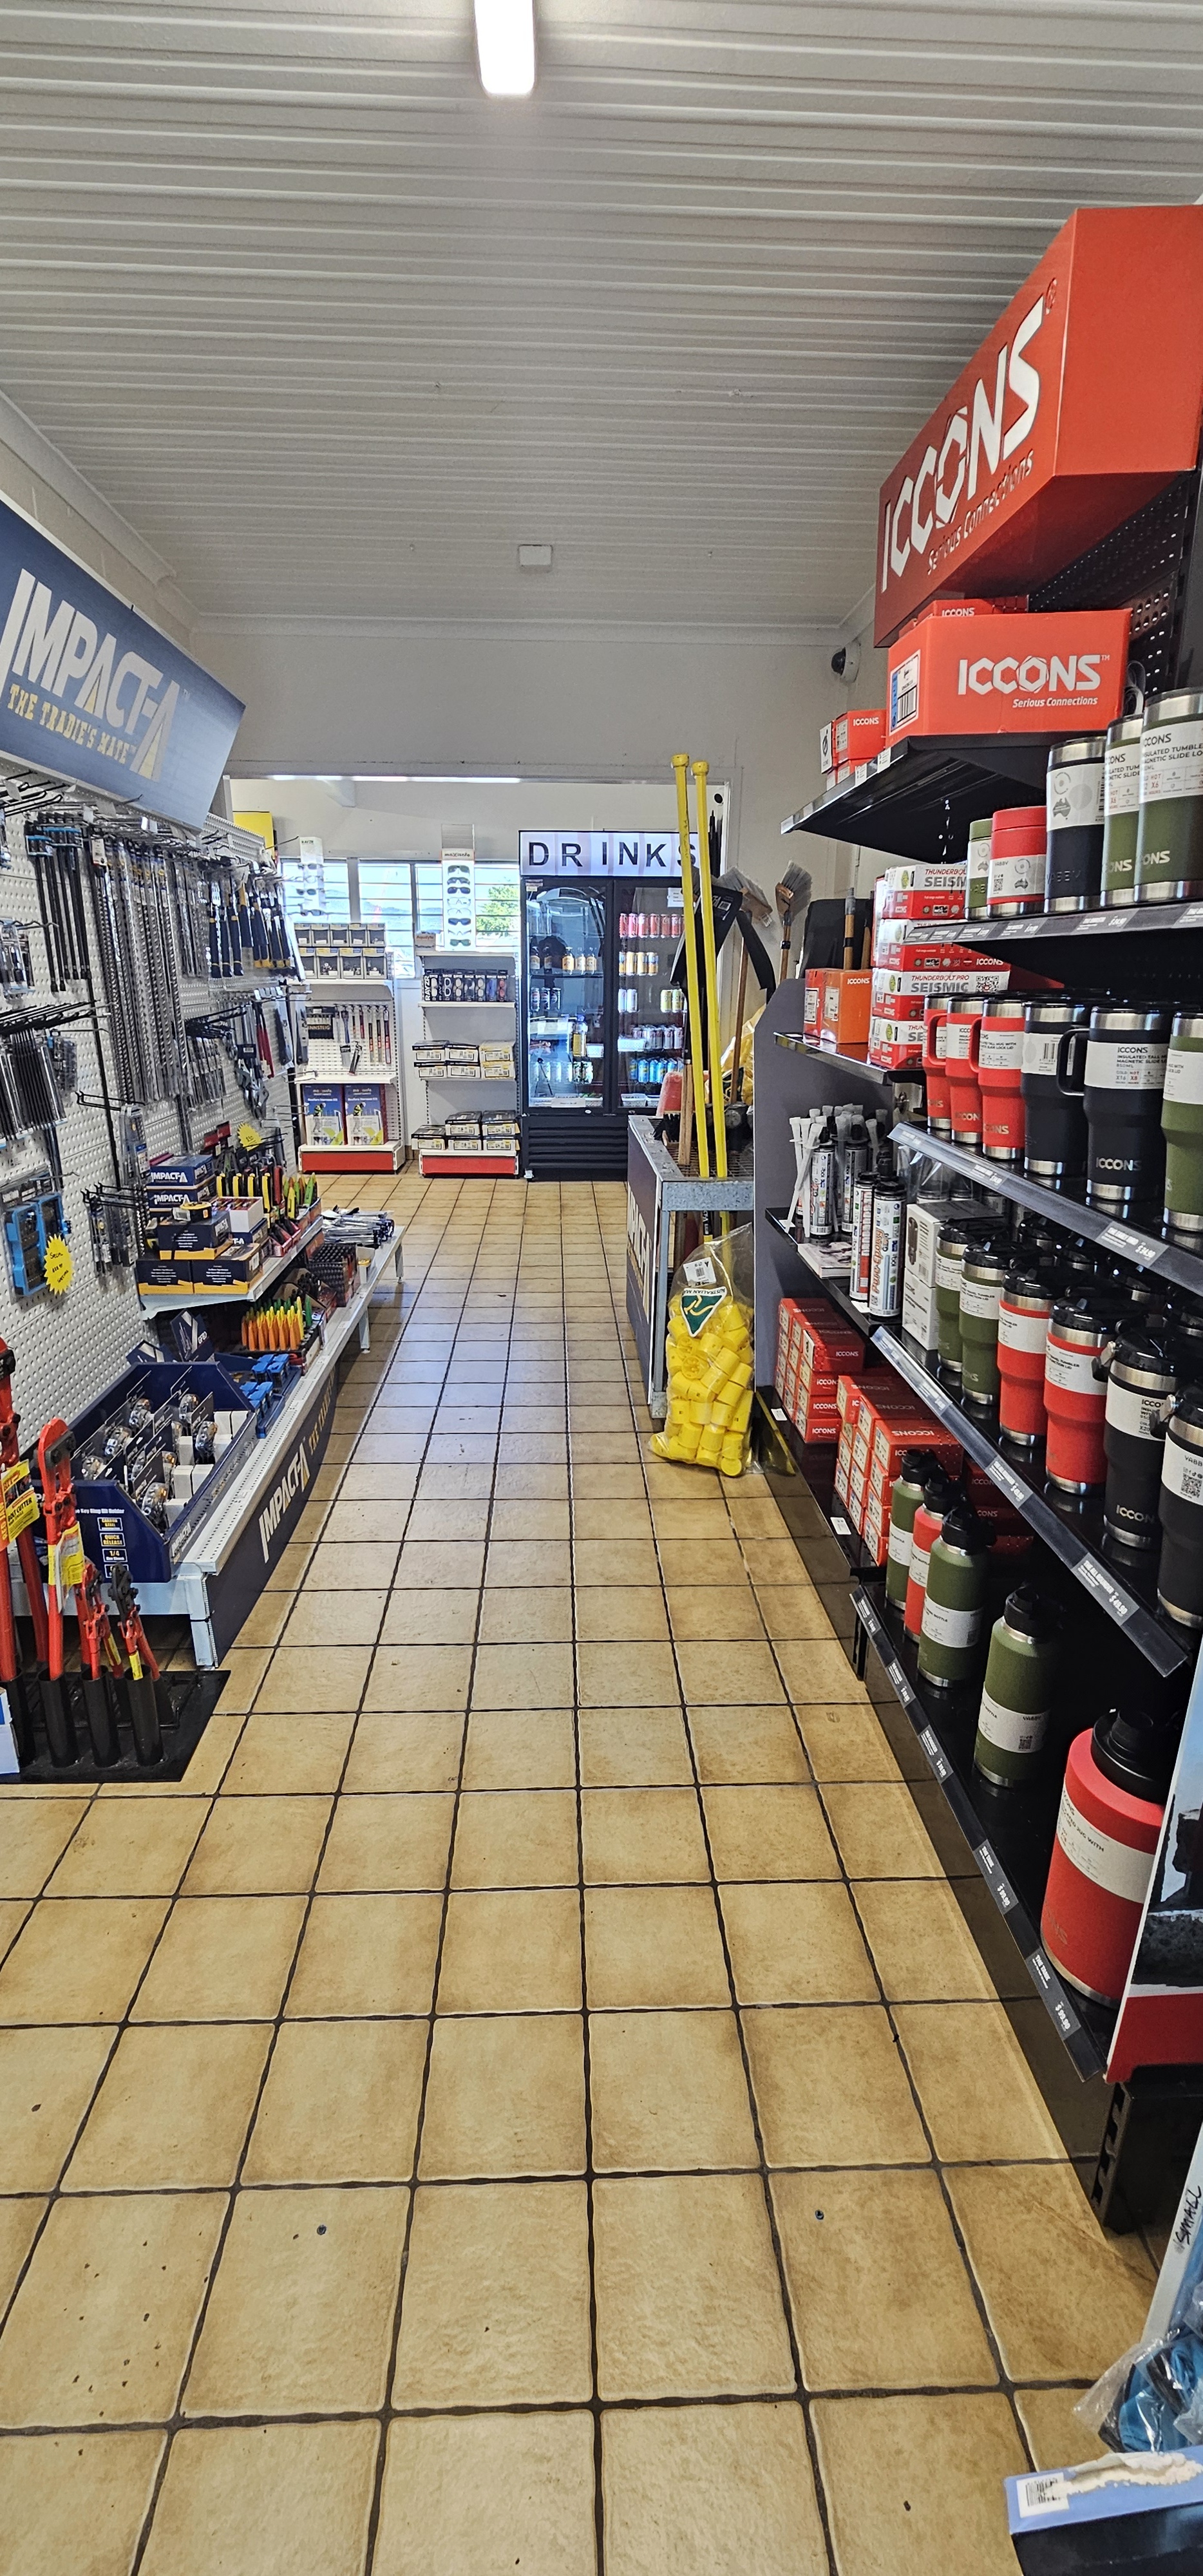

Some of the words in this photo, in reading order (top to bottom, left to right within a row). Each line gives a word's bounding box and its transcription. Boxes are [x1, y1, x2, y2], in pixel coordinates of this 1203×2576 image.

[881, 294, 1045, 593] ICCONS
[927, 526, 961, 576] Serious
[963, 449, 1034, 538] Connections
[942, 607, 975, 617] ICCONS
[0, 568, 180, 782] IMPACT-A
[958, 655, 1101, 696] ICCONS
[1012, 698, 1045, 708] Serious
[1046, 696, 1098, 706] Connections
[8, 683, 37, 721] THE
[39, 701, 97, 749] TRADIE'S
[97, 732, 131, 764] MATE
[853, 717, 880, 726] ICCONS
[1143, 733, 1172, 747] CCONS
[1144, 748, 1170, 757] SULATED
[1172, 743, 1203, 753] TUMBLE
[1168, 752, 1190, 761] SLIDE
[1142, 850, 1170, 865] ONS
[1110, 859, 1132, 872] ONS
[924, 876, 967, 887] SEISM
[911, 982, 969, 992] SEISMIC
[1096, 1157, 1142, 1171] ICCONS
[151, 1171, 188, 1183] IMPACT-A
[154, 1194, 190, 1205] IMPACT-A
[1141, 1398, 1162, 1408] ICCO
[1184, 1455, 1203, 1467] YABB
[8, 1509, 17, 1522] BOLT
[16, 1497, 33, 1513] CUTTER
[258, 1443, 310, 1564] IMPACT-A
[1116, 1504, 1155, 1524] ICCON
[1077, 1826, 1086, 1839] JUG
[1087, 1837, 1104, 1852] WITH
[1035, 1954, 1043, 1967] THE
[1041, 1965, 1051, 1982] TANK
[1055, 2003, 1070, 2030] $99.90
[1175, 2185, 1202, 2246] SMALL
